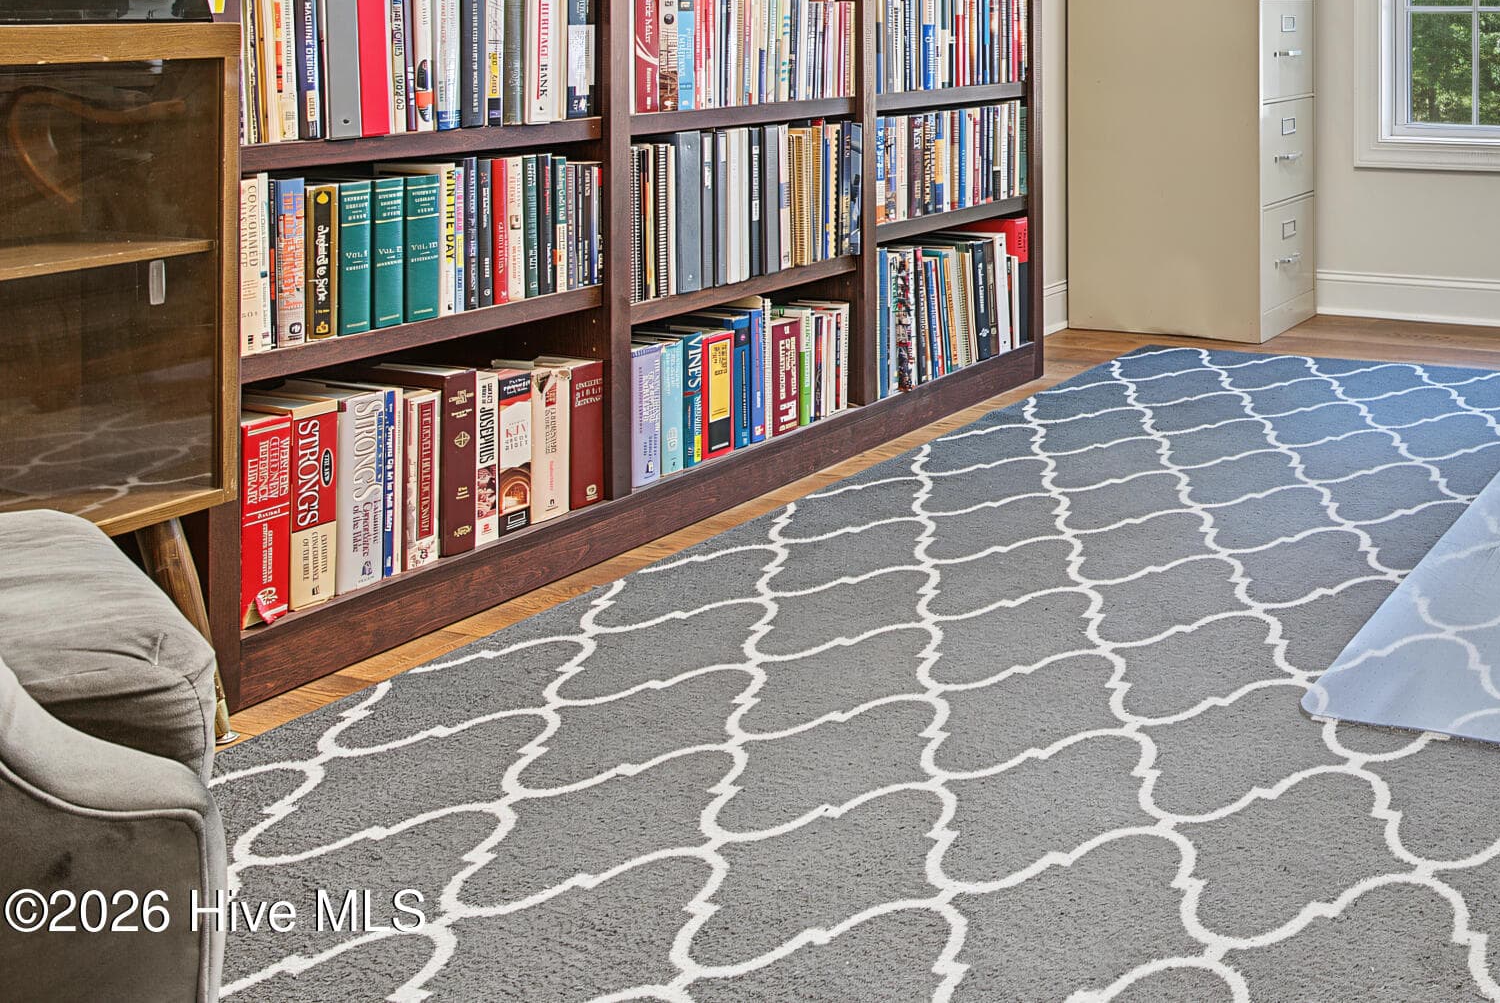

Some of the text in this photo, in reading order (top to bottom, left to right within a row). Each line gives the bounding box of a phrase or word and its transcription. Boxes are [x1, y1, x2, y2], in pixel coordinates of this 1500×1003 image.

[541, 3, 549, 58] HERITAGE
[540, 64, 548, 98] BANK
[446, 170, 455, 260] WIN THE DAY
[688, 334, 702, 388] VINE'S
[353, 399, 384, 502] STRONG'S
[479, 407, 494, 464] JOSEPHUS
[297, 420, 320, 527] STRONG'S
[361, 502, 373, 557] Concordance
